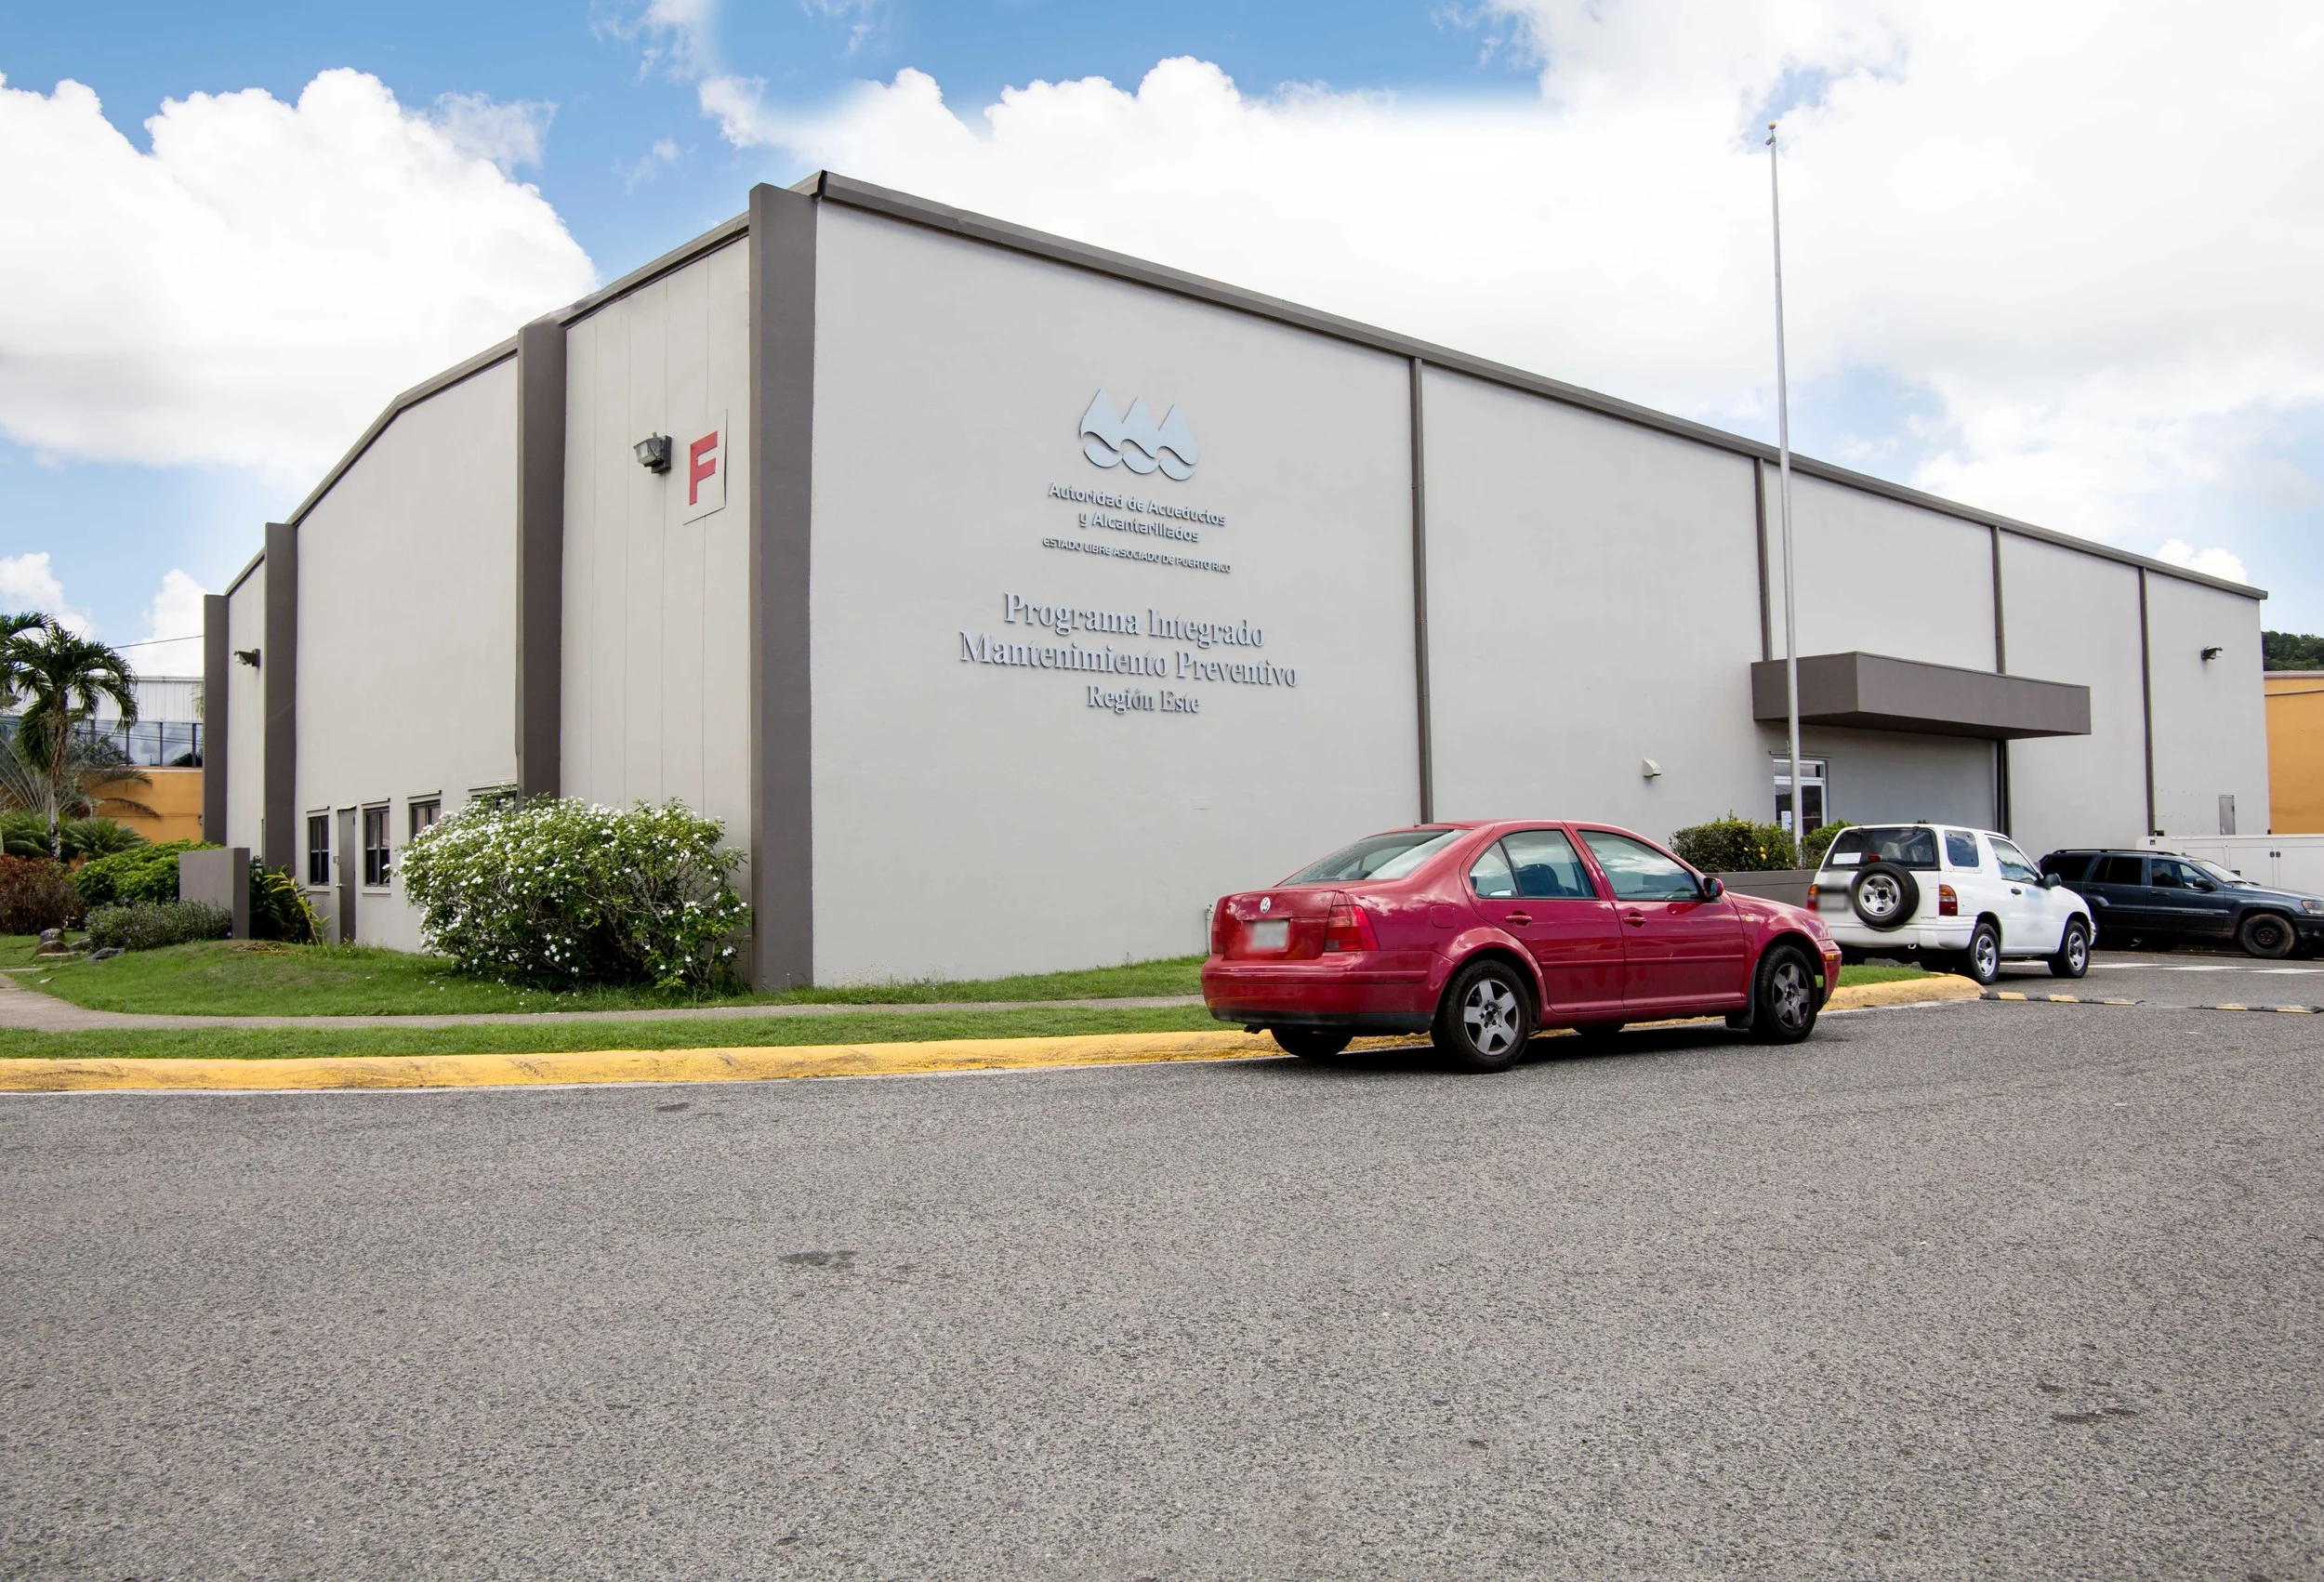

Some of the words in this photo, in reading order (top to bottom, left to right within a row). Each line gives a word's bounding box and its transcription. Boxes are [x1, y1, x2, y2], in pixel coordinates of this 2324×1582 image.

[689, 430, 718, 506] F
[1048, 481, 1124, 508] Autoridad
[1127, 496, 1144, 512] de
[1148, 499, 1226, 526] Acueductos
[1079, 512, 1088, 527] y
[1092, 512, 1198, 542] Alcantarillados
[1042, 536, 1081, 551] ESTADO
[1084, 543, 1111, 556] LIBRE
[1113, 547, 1161, 563] ASOCIADO
[1161, 555, 1175, 565] DE
[1175, 557, 1210, 570] PUERTO
[1210, 561, 1232, 573] RICO
[1004, 590, 1141, 636] Programa
[1148, 607, 1266, 649] Integrado
[960, 629, 1169, 679] Mantenimiento
[1176, 650, 1299, 688] Preventivo
[1087, 683, 1155, 714] Región
[1160, 689, 1201, 713] Este
